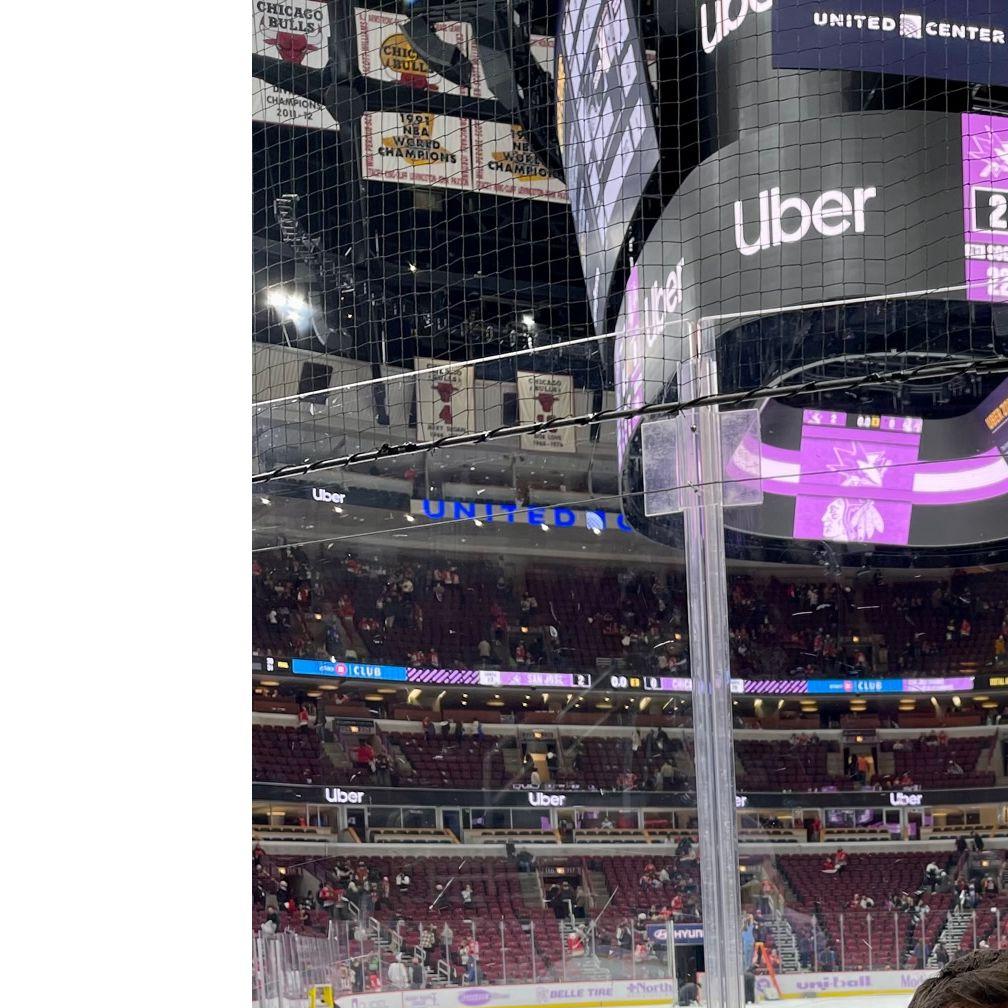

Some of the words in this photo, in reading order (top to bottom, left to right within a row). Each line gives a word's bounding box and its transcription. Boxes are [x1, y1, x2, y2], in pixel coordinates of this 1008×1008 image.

[257, 1, 323, 21] CHICAGO
[269, 16, 315, 34] BULLS
[813, 12, 896, 31] UNITED
[925, 21, 1006, 44] CENTER
[383, 45, 418, 61] CHIC
[392, 58, 429, 73] BULL
[266, 95, 322, 110] CHAMPIONS
[401, 113, 430, 126] 1991
[403, 125, 430, 137] NBA
[393, 136, 440, 149] WORLD
[512, 141, 530, 151] NB
[378, 146, 457, 164] CHAMPIONS
[503, 151, 543, 165] WORL
[488, 160, 551, 178] CHAMPIO
[989, 194, 1008, 229] 2
[734, 187, 877, 256] Uber
[645, 257, 685, 347] Uber
[312, 487, 346, 504] Uber
[422, 498, 576, 529] UNITED
[353, 665, 382, 677] CLUB
[672, 677, 692, 689] CHIC
[857, 680, 882, 691] CLUB
[325, 787, 365, 804] Uber
[528, 792, 567, 807] Uber
[735, 795, 747, 808] er
[889, 792, 923, 806] Uber
[674, 929, 704, 939] HYUN
[901, 974, 924, 988] Mod
[550, 988, 584, 998] BELLE
[588, 987, 613, 997] TIRE
